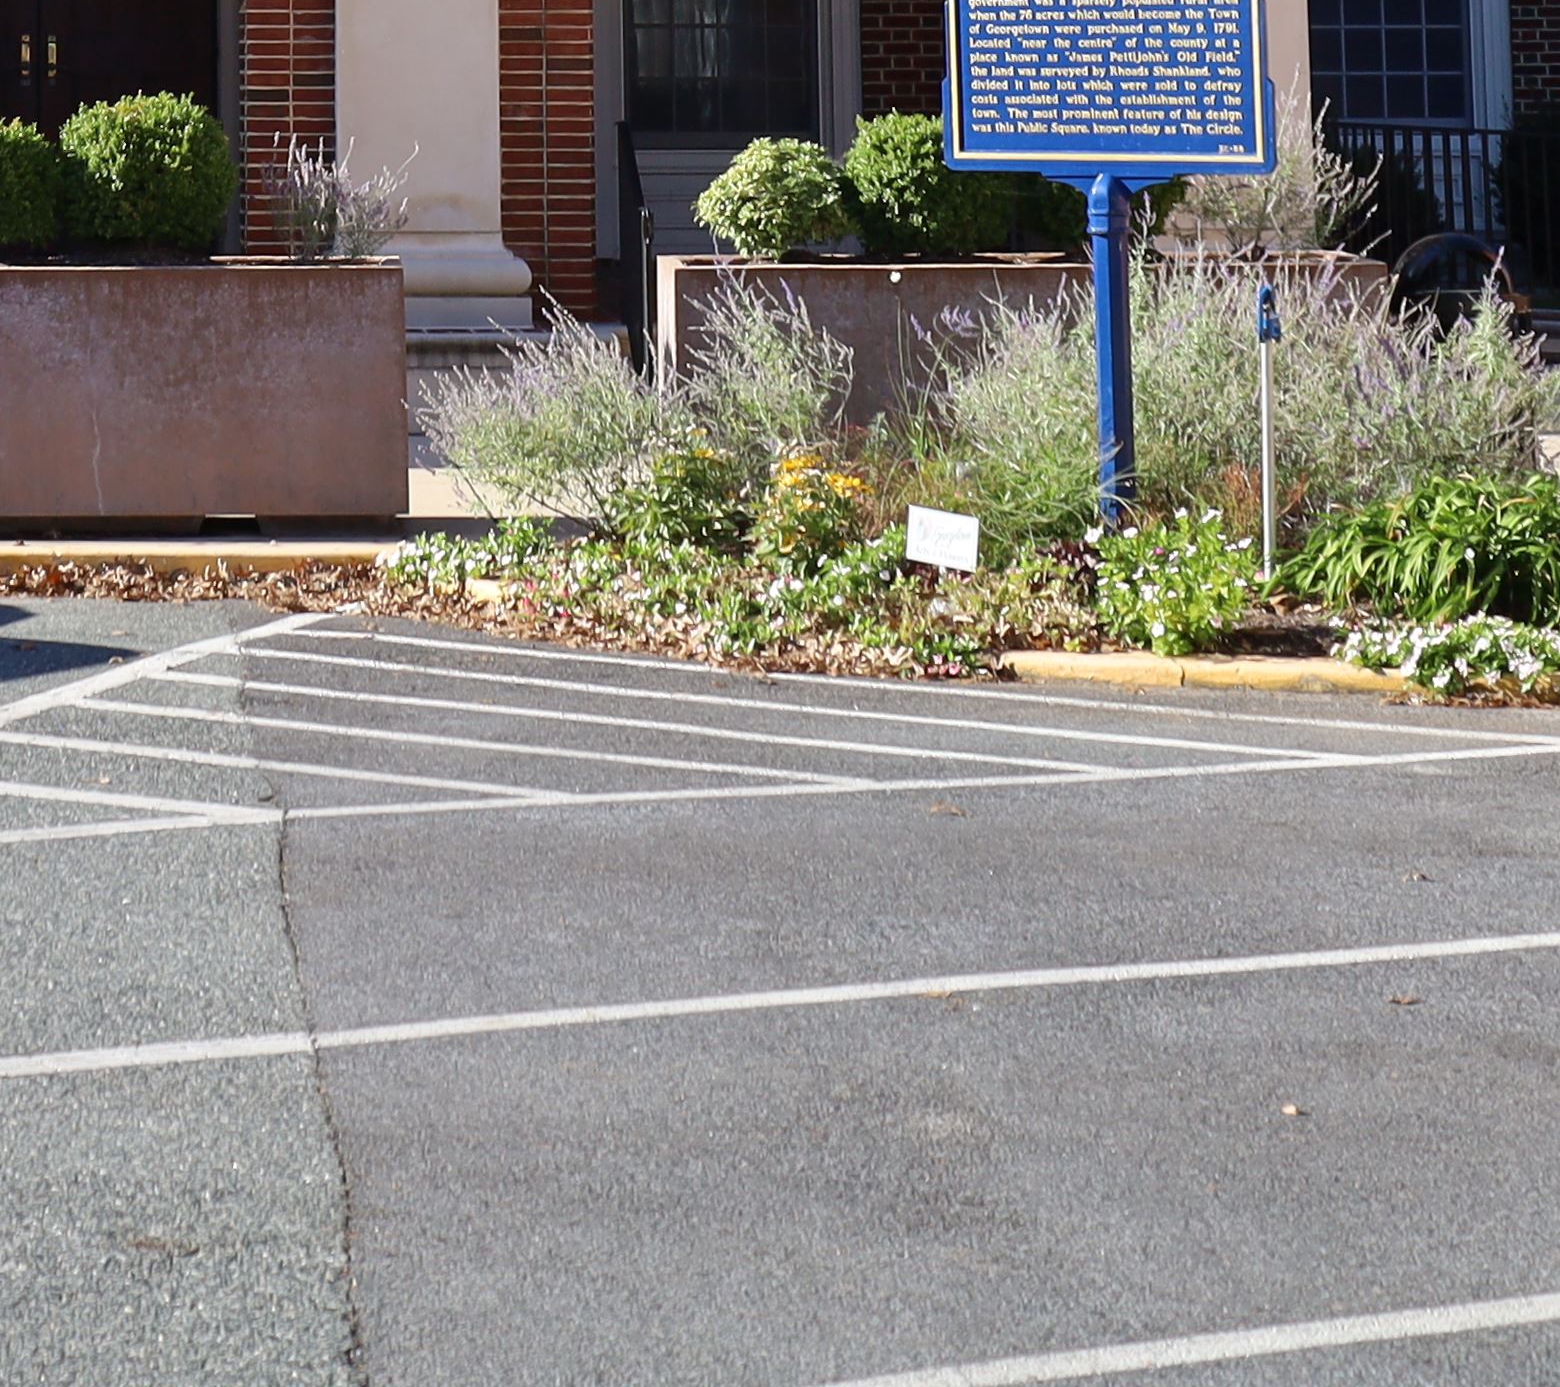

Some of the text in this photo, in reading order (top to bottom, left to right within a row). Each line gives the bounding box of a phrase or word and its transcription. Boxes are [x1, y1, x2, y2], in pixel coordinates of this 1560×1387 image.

[968, 8, 1240, 20] when the 76 acres which would become the Town
[968, 23, 981, 35] of
[985, 23, 1050, 37] Georgetown
[1054, 25, 1082, 35] were
[1087, 23, 1144, 37] purchased
[1148, 25, 1163, 35] on
[1167, 23, 1191, 37] May
[969, 37, 1011, 49] Located
[1053, 37, 1072, 49] the
[1124, 37, 1138, 49] of
[1144, 37, 1164, 49] the
[1169, 37, 1209, 51] county
[1214, 37, 1227, 49] at
[1232, 39, 1241, 49] a
[969, 51, 998, 65] place
[1004, 51, 1040, 63] known
[1046, 53, 1059, 63] as
[1176, 51, 1198, 63] Old
[970, 65, 989, 77] the
[991, 65, 1015, 77] land
[1017, 67, 1037, 77] was
[1039, 65, 1089, 79] surveyed
[1091, 65, 1107, 79] by
[1109, 65, 1150, 77] Rhoads
[1217, 65, 1242, 77] who
[970, 79, 1242, 93] divided it into lots which were sold to defray
[971, 93, 1242, 105] costs associated with the establishment of the
[1006, 107, 1029, 119] The
[1032, 107, 1058, 119] most
[1061, 107, 1120, 122] prominent
[1122, 107, 1165, 119] feature
[1168, 108, 1182, 120] of
[1185, 108, 1202, 120] his
[1204, 108, 1243, 122] design
[971, 123, 993, 133] was
[994, 121, 1015, 133] this
[1016, 121, 1049, 133] Public
[1092, 122, 1128, 134] known
[1129, 122, 1161, 136] today
[1163, 124, 1177, 134] as
[1180, 122, 1204, 134] The
